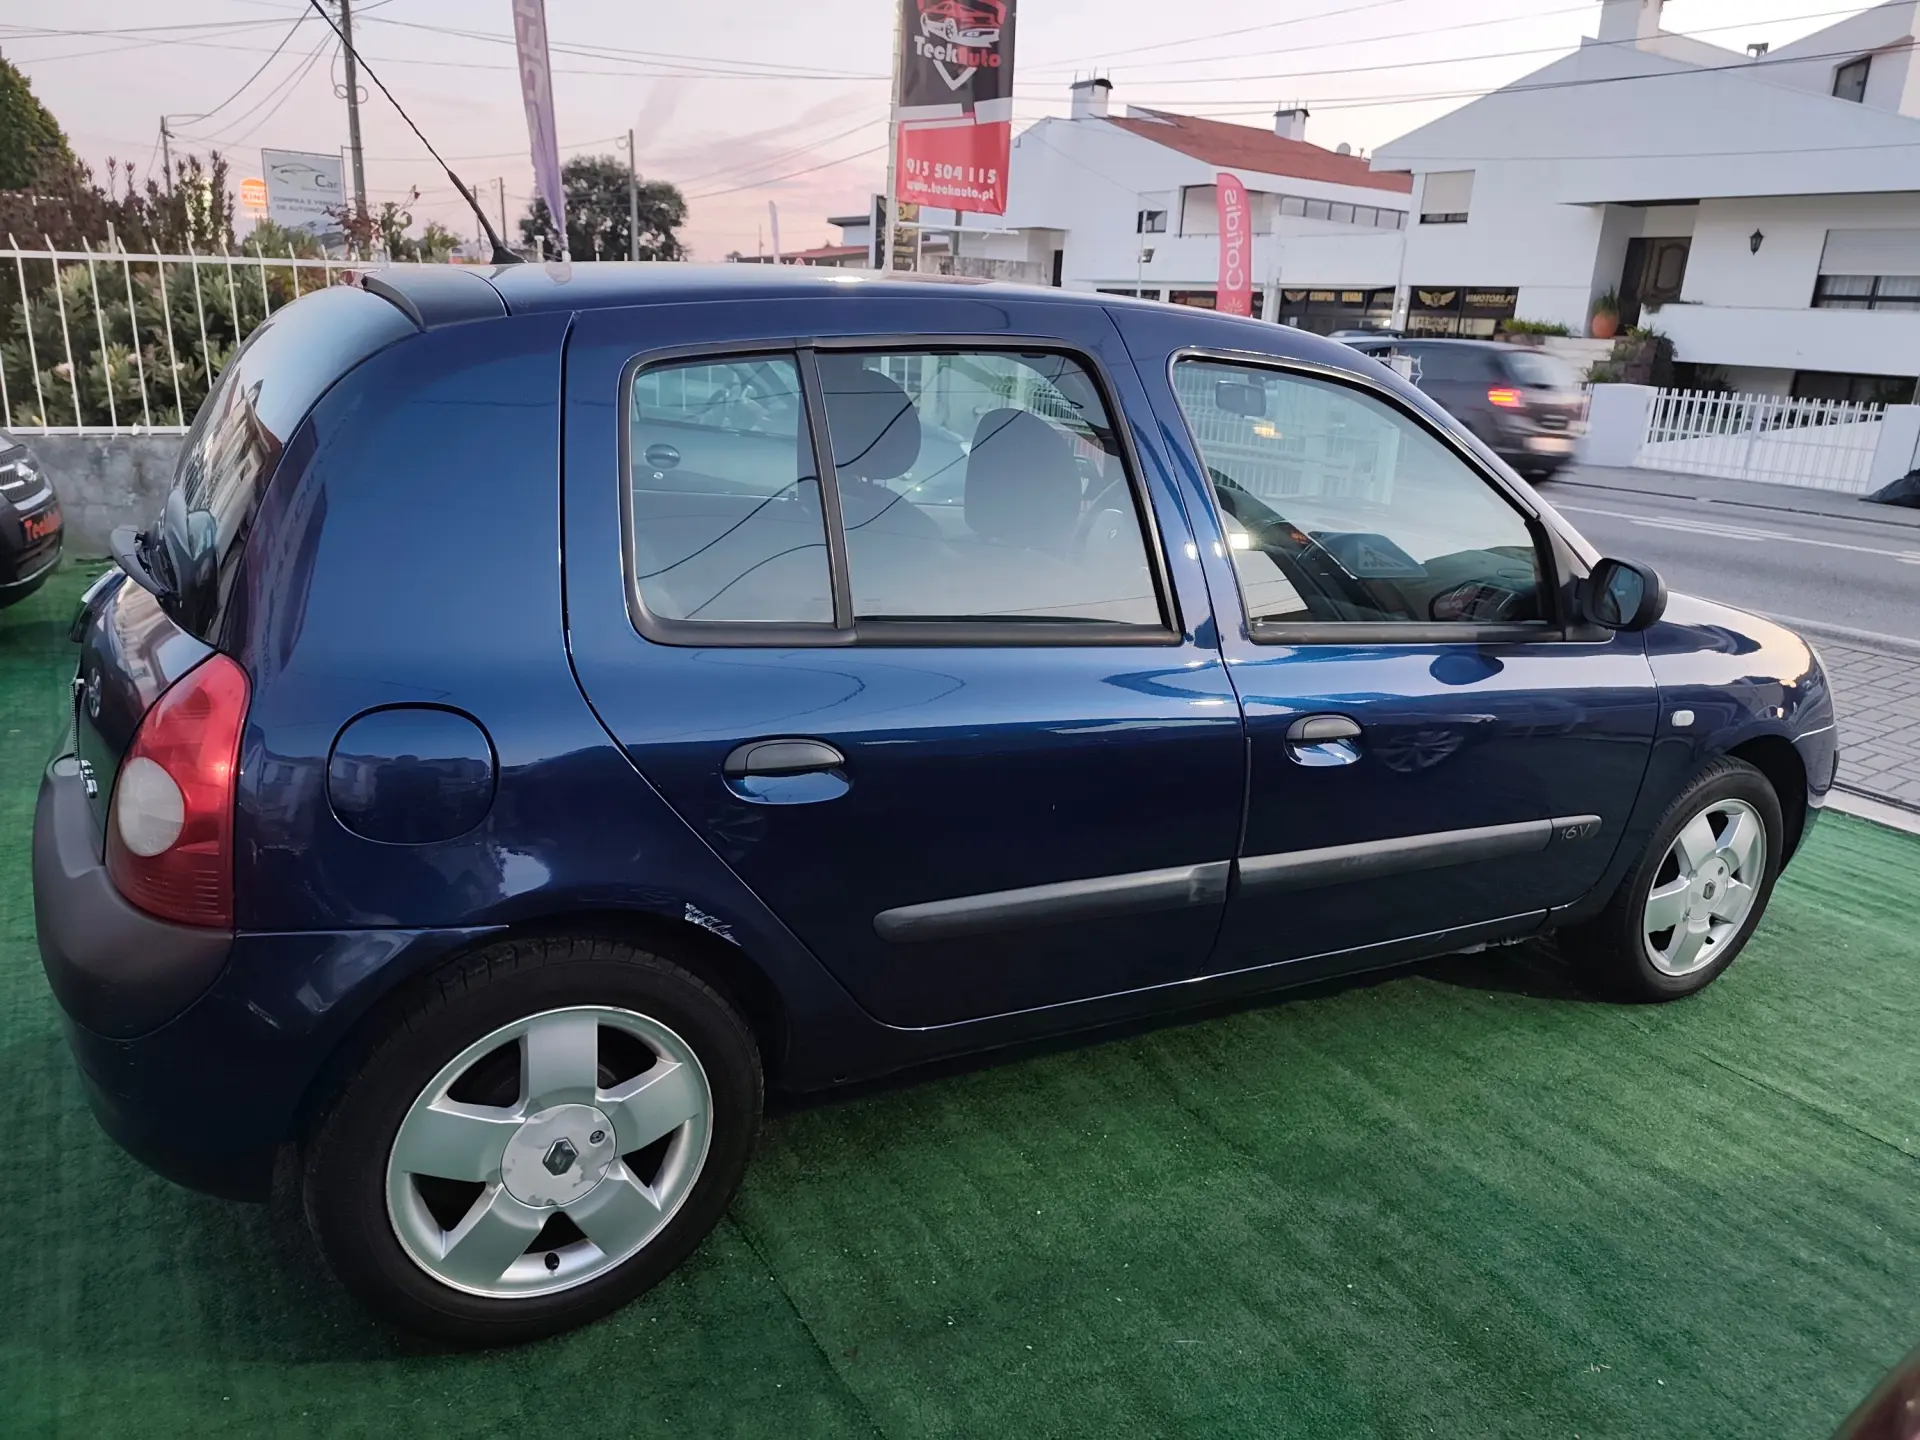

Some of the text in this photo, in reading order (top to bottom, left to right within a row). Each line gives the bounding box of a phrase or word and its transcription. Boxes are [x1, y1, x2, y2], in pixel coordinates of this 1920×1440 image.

[913, 35, 1002, 68] TeckAuto
[906, 157, 930, 178] 915
[934, 163, 962, 181] 504
[314, 174, 338, 189] Car
[1560, 823, 1591, 840] 16V
